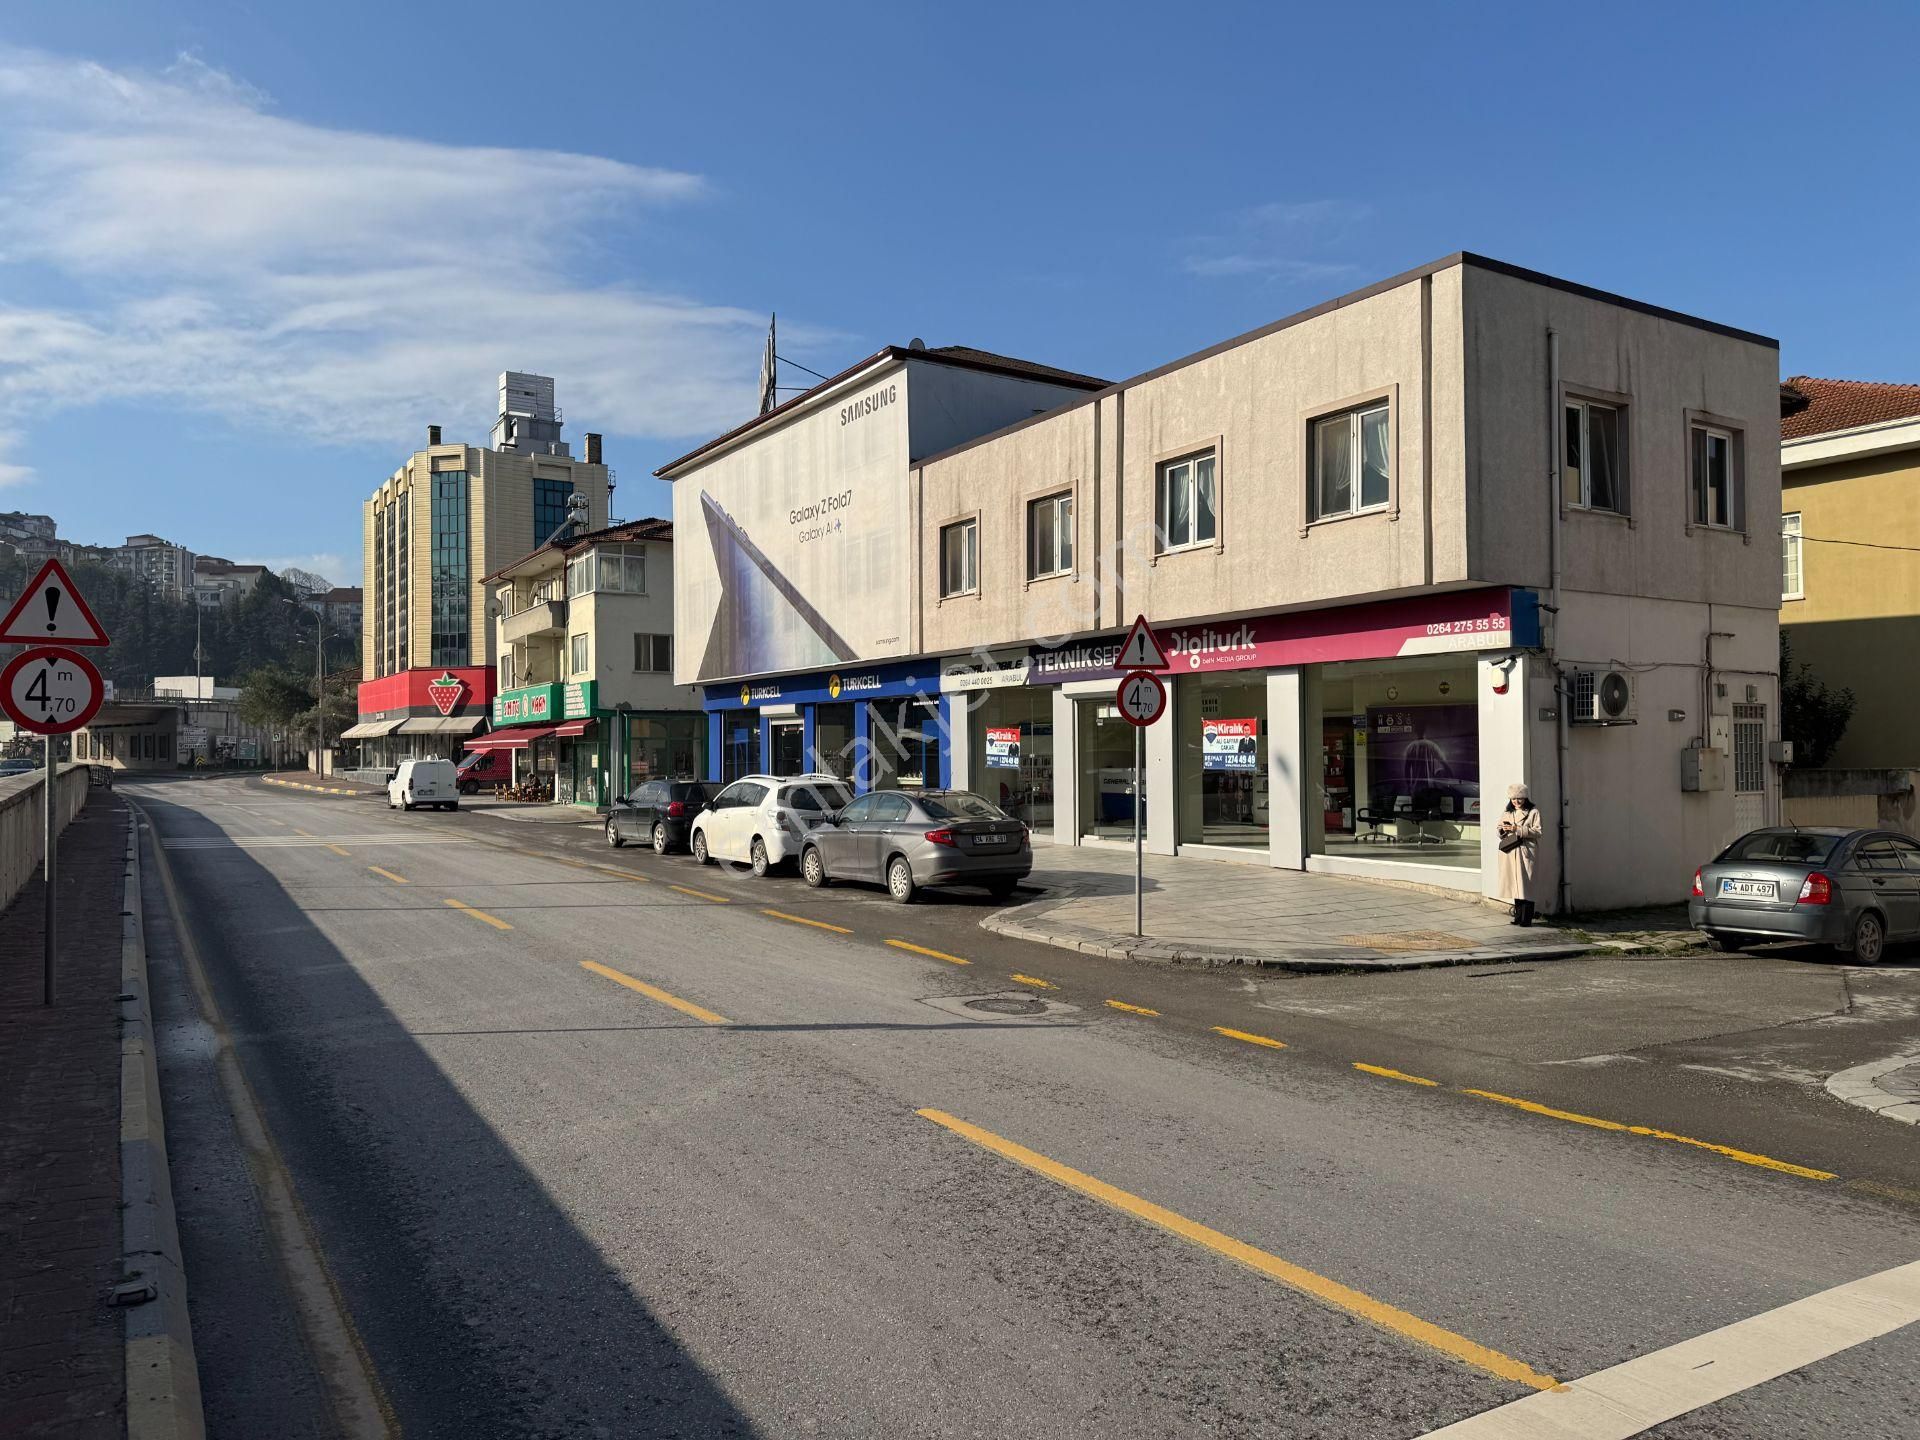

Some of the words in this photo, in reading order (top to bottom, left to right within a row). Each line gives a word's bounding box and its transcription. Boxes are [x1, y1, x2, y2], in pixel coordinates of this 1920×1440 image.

[840, 384, 896, 427] SAMSUNG
[789, 503, 821, 525] Galaxy
[821, 498, 827, 515] Z
[828, 489, 852, 512] Fold7
[799, 526, 825, 544] Galaxy
[1427, 623, 1451, 635] 0264
[1454, 620, 1473, 633] 275
[1476, 618, 1490, 630] 55
[1492, 617, 1505, 629] 55
[1448, 633, 1504, 649] ARABUL
[1094, 645, 1121, 667] SER
[1235, 653, 1257, 661] GROUP
[842, 674, 882, 691] TURKCELL
[751, 685, 781, 700] TURKCELL
[1728, 881, 1737, 891] 54
[1740, 883, 1754, 892] ADT
[1757, 885, 1771, 893] 497
